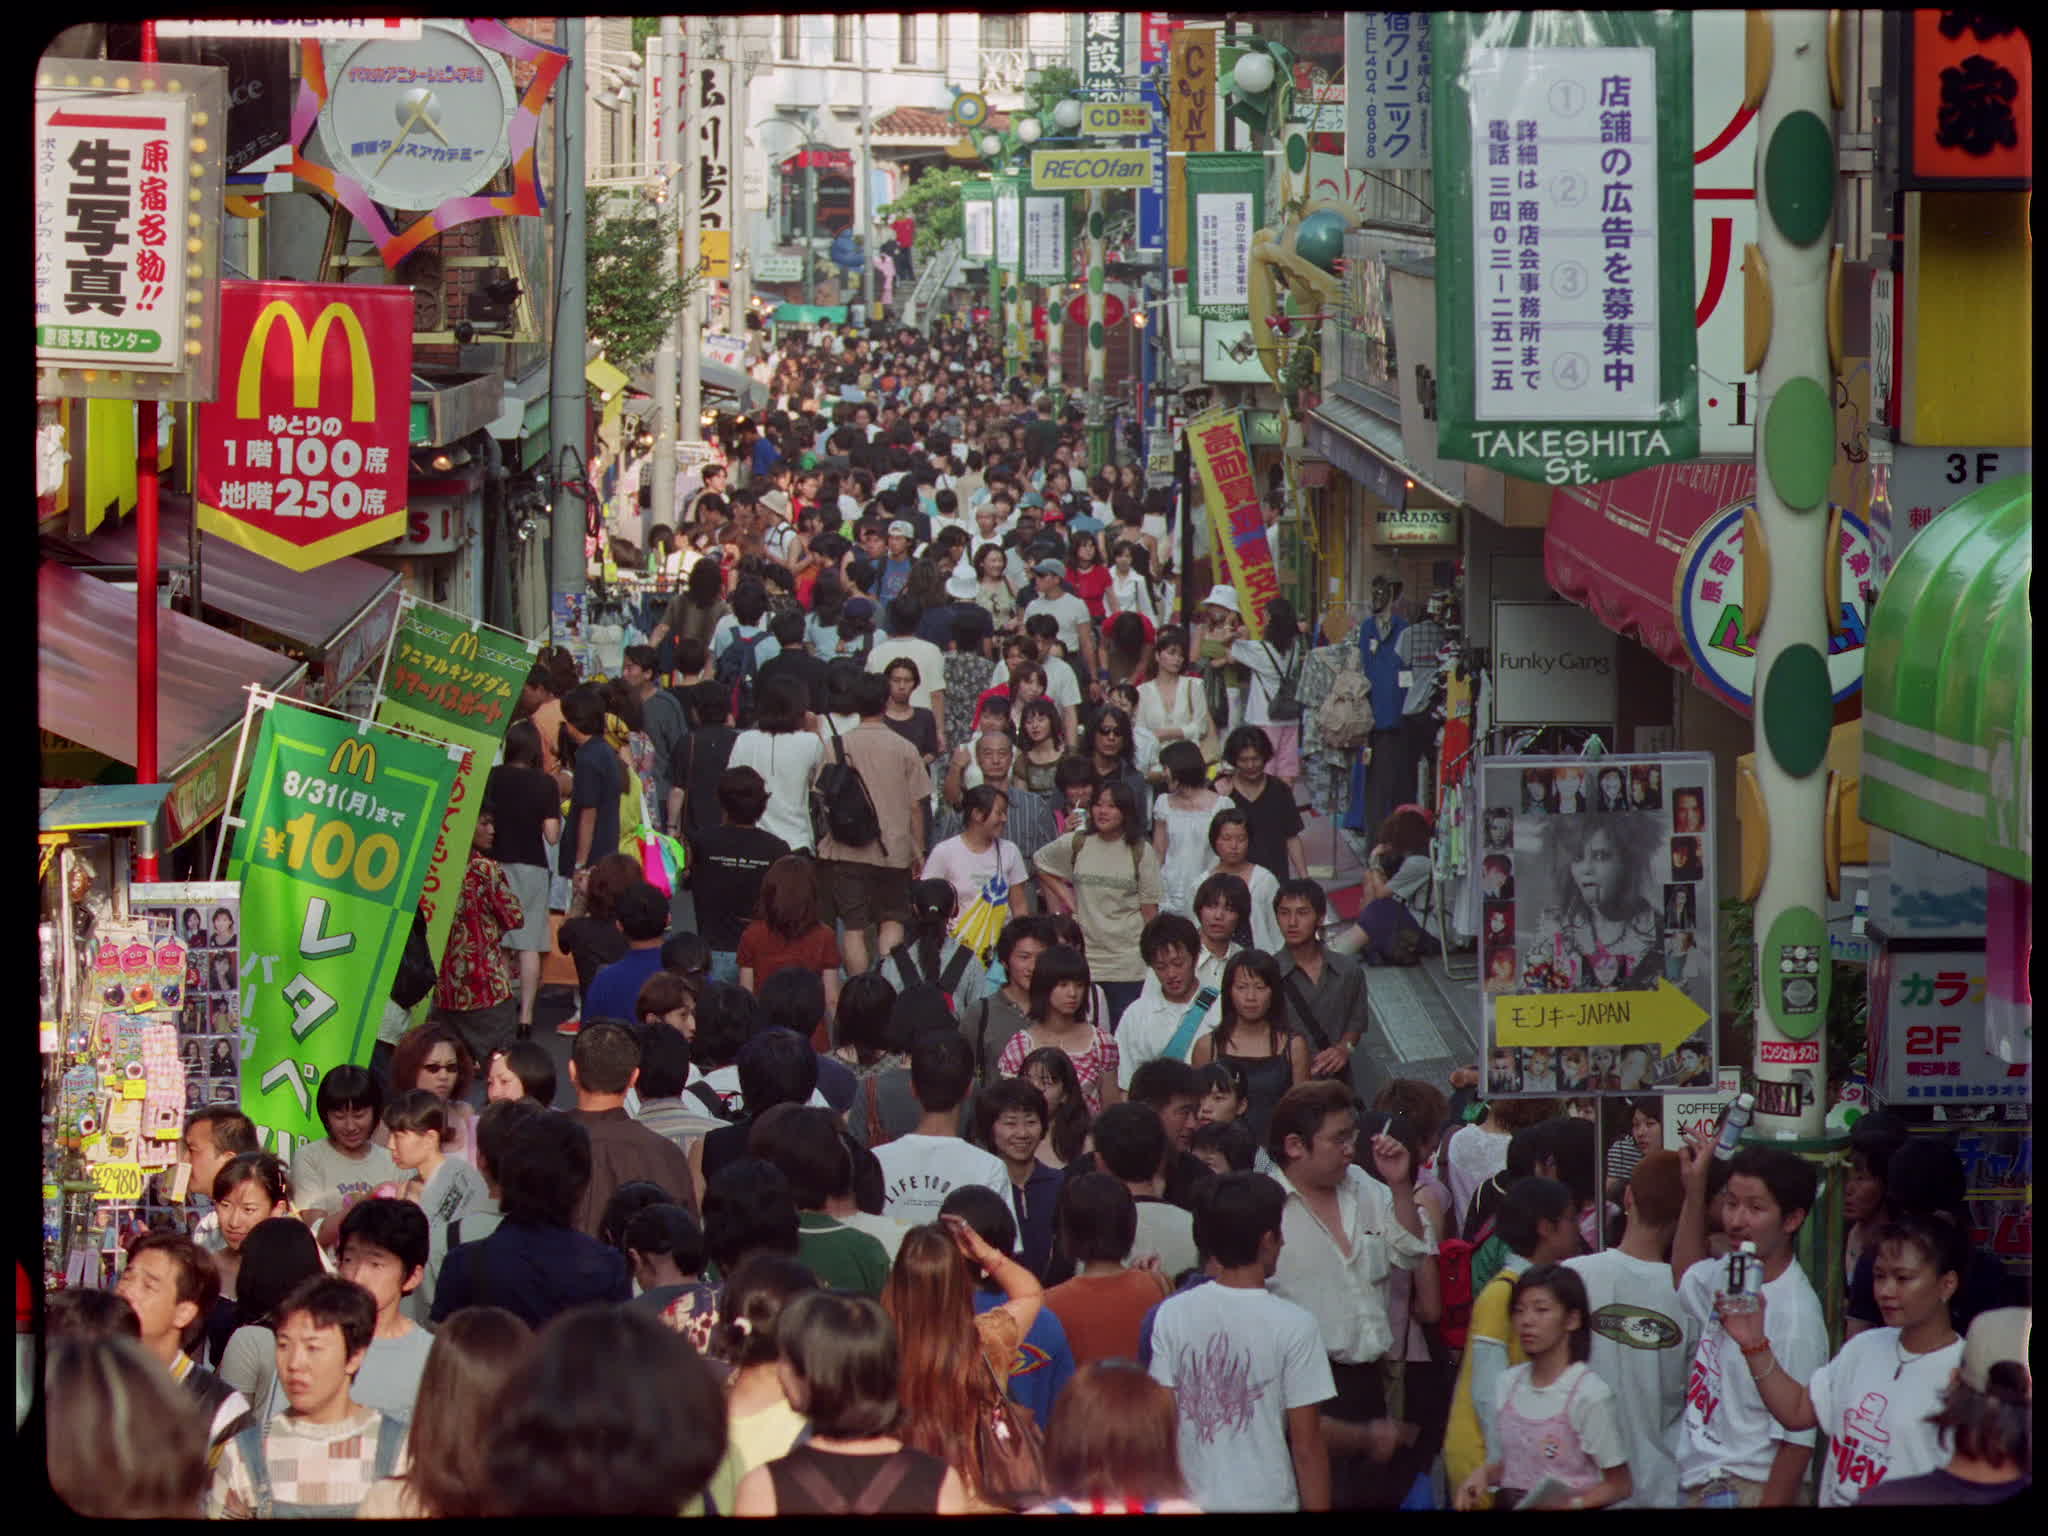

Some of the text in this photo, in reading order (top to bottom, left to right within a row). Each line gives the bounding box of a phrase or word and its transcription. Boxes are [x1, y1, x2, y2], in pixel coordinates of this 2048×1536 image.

[1090, 109, 1120, 126] CD
[1488, 120, 1510, 166] 電話
[1042, 158, 1144, 179] RECOfan
[64, 138, 131, 317] 生写真
[1600, 75, 1634, 392] 店舗の広告を募集中
[267, 414, 342, 438] ゆとりの
[1472, 430, 1672, 458] TAKESHITA
[1545, 457, 1600, 486] St.
[219, 478, 388, 520] 地階250席
[1500, 652, 1611, 674] Funky Gang
[261, 812, 401, 892] ¥100
[1906, 1025, 1961, 1055] 2F
